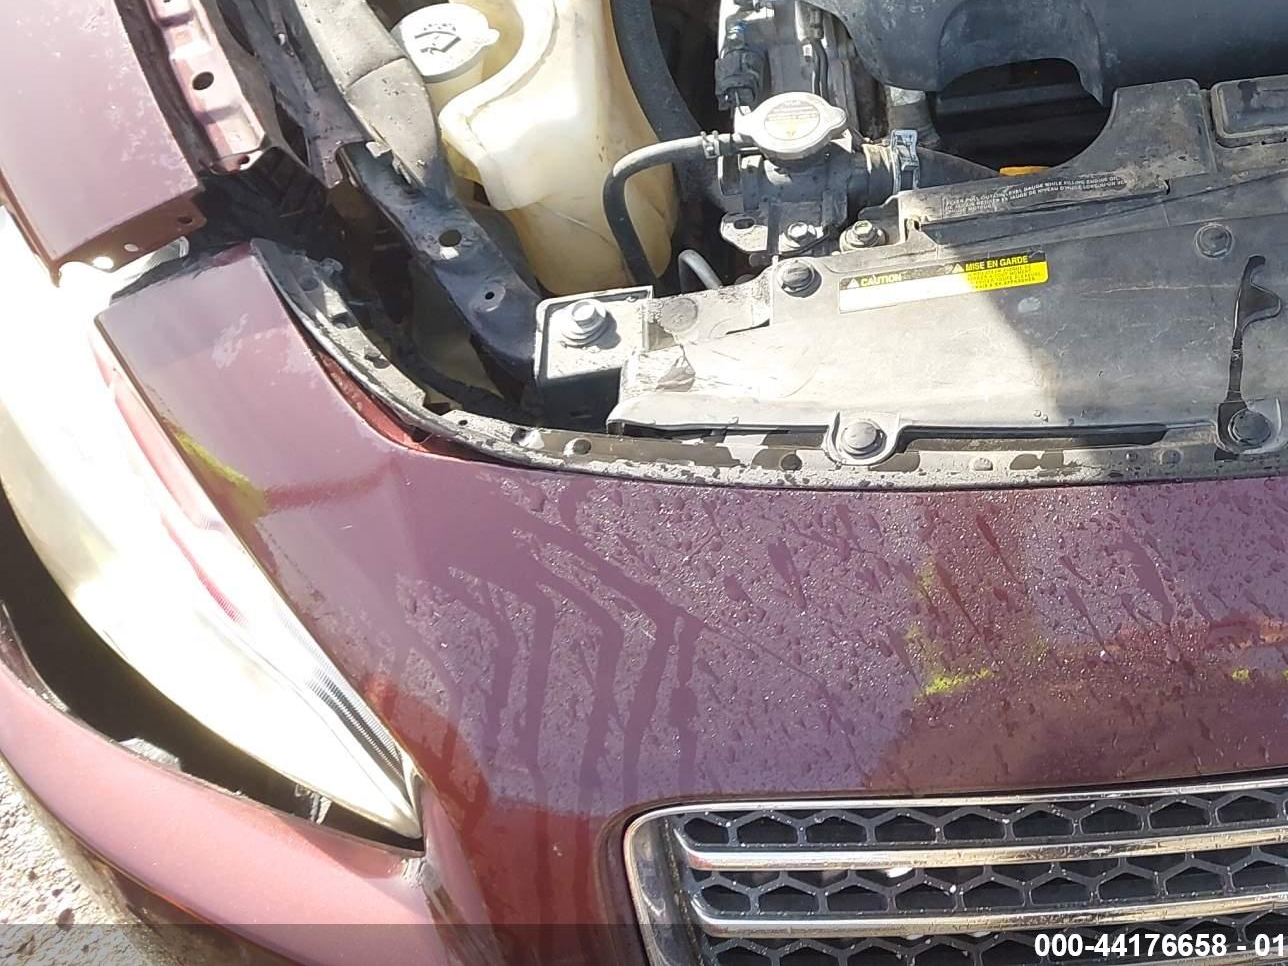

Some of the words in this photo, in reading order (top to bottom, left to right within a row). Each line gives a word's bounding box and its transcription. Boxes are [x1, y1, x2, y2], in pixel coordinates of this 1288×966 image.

[965, 260, 985, 272] MISE
[986, 259, 999, 269] EN
[999, 255, 1029, 267] GARDE
[861, 273, 902, 287] CAUTION
